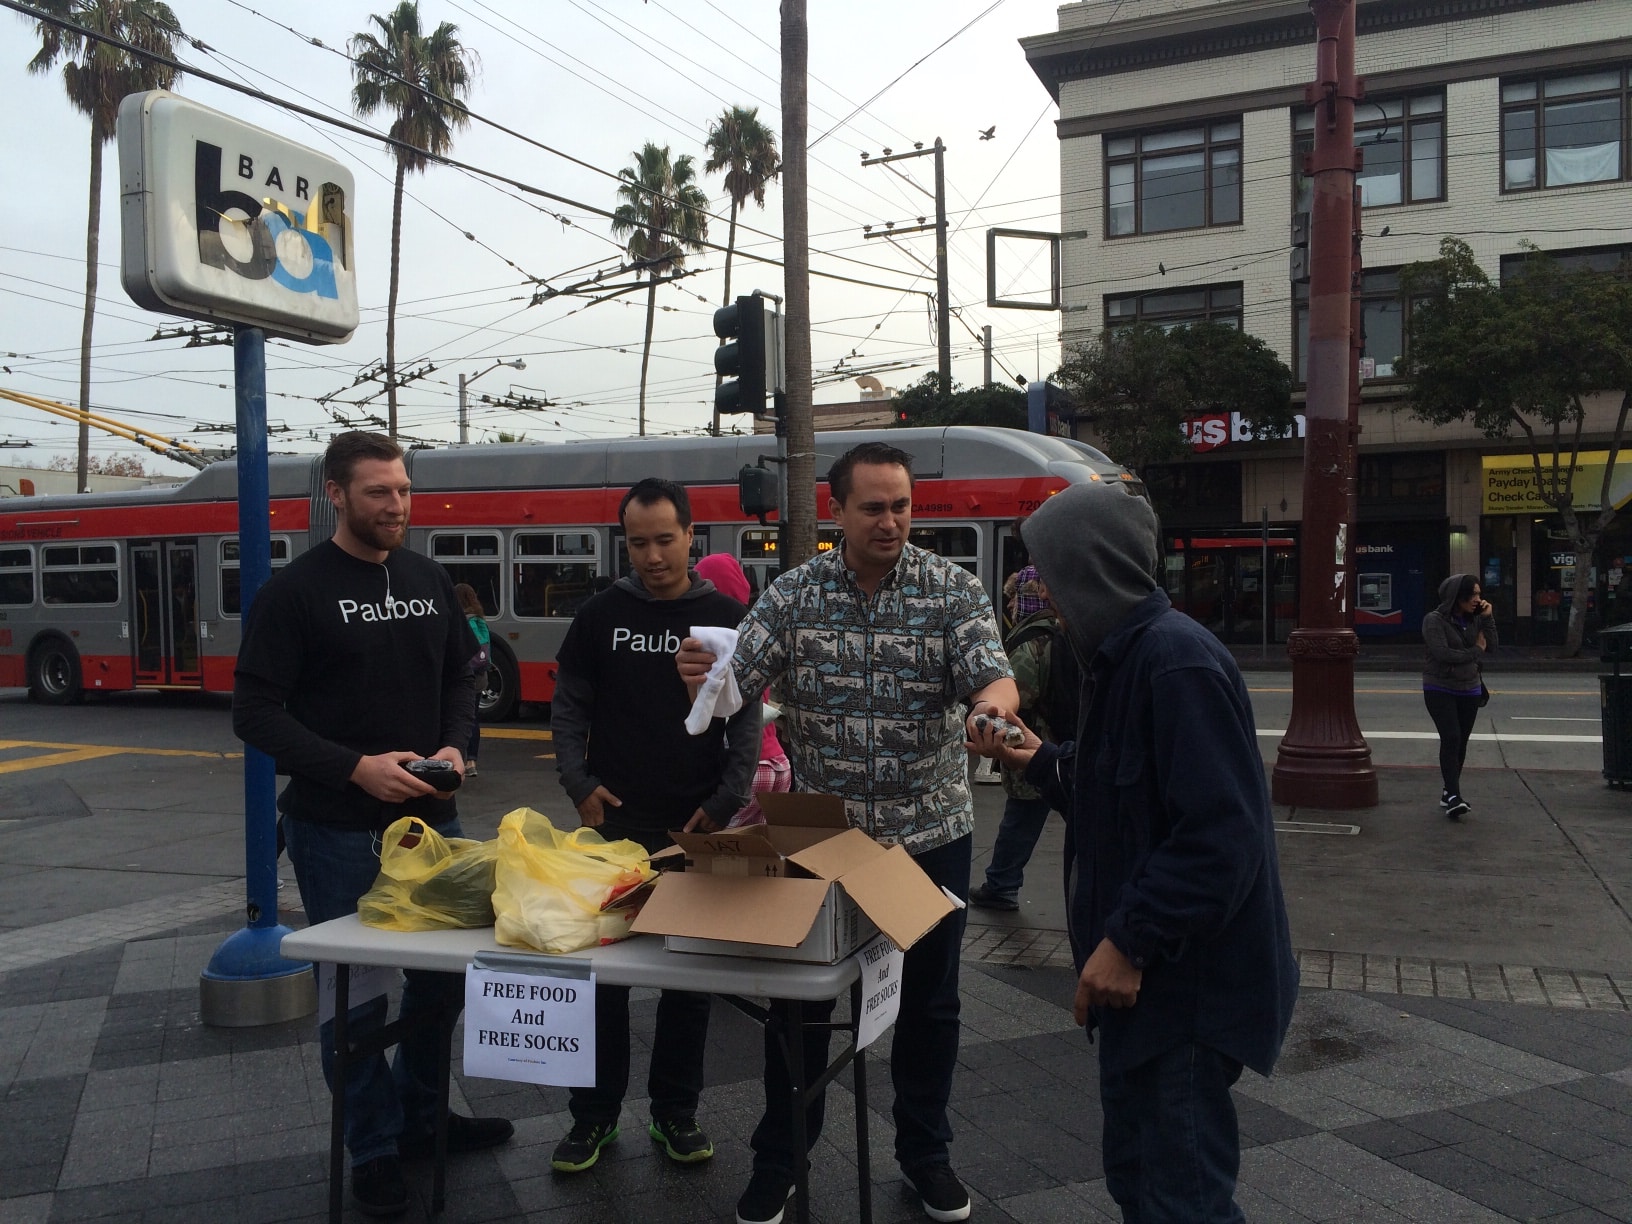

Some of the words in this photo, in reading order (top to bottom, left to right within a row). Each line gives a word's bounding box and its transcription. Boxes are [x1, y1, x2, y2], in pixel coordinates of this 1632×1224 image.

[1489, 468, 1510, 476] Army
[1489, 477, 1530, 489] Payday
[1018, 500, 1045, 511] 720
[1489, 491, 1524, 502] Check
[764, 542, 776, 551] 14
[1355, 544, 1394, 553] usbank
[338, 598, 439, 624] Paubox
[612, 627, 681, 654] Paub
[863, 945, 881, 966] FREE
[877, 963, 890, 984] And
[482, 981, 525, 999] FREE
[530, 985, 577, 1004] FOOD
[865, 991, 881, 1015] FREE
[880, 979, 899, 1004] SOCKS
[511, 1008, 545, 1026] And
[478, 1029, 520, 1048] FREE
[524, 1034, 580, 1053] SOCKS
